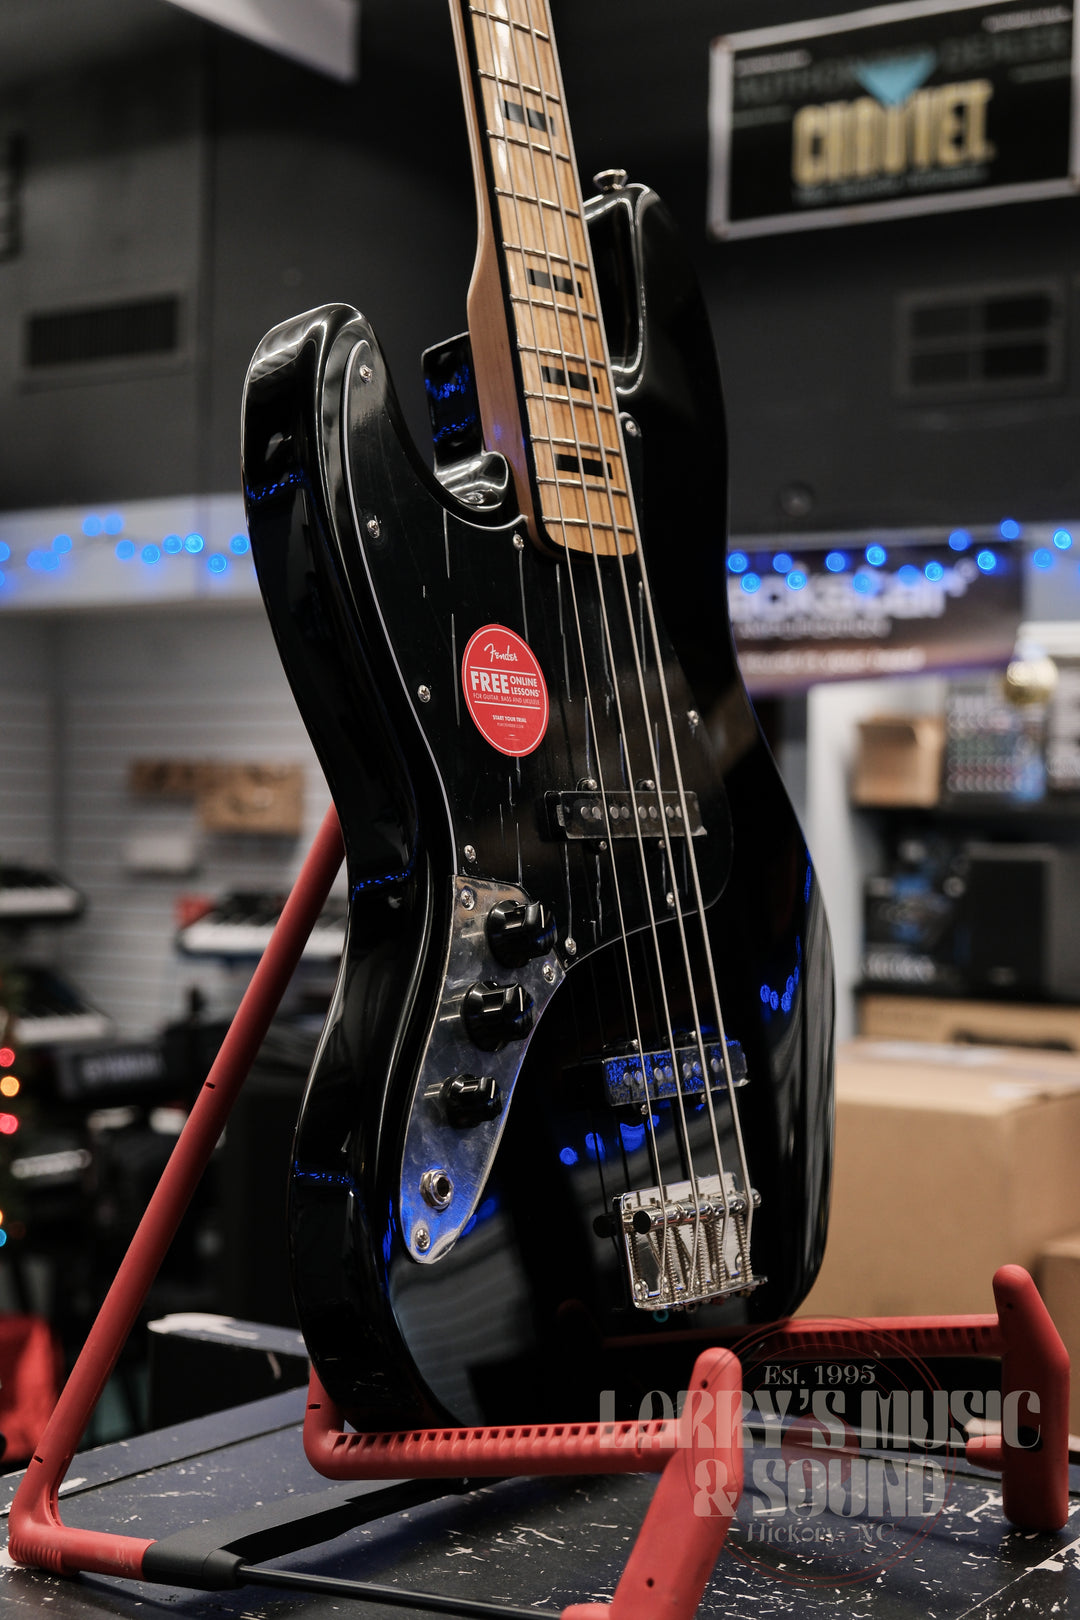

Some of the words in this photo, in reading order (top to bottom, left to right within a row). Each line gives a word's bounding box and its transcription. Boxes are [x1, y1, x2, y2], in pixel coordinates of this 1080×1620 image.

[484, 643, 518, 662] Fender
[470, 670, 510, 694] FREE
[510, 676, 537, 687] ONLINE
